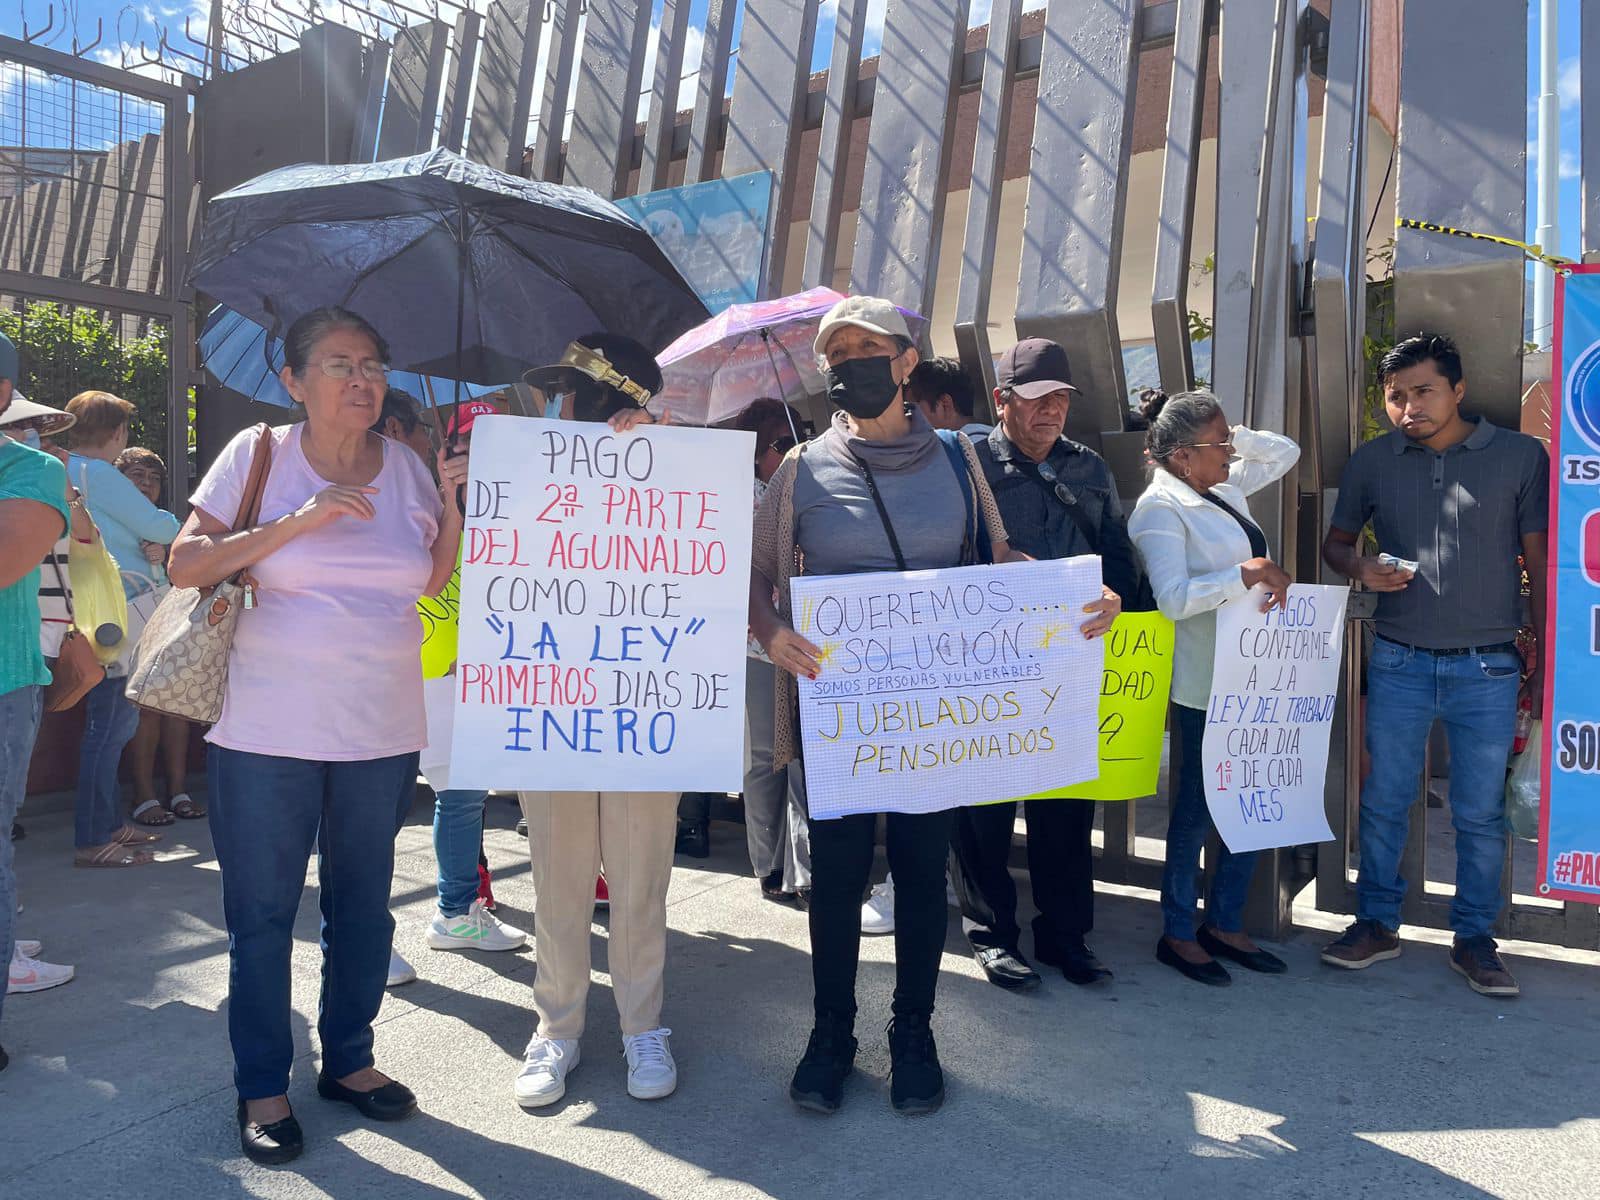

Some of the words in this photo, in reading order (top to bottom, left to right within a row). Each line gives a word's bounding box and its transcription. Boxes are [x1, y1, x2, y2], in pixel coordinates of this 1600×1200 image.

[541, 430, 653, 481] PAGO
[467, 480, 511, 520] DE
[601, 483, 720, 531] PARTE
[464, 527, 530, 566] DEL
[547, 529, 726, 575] AGUINALDO
[486, 575, 586, 615] COMO
[598, 580, 681, 618] DICE
[1109, 629, 1163, 657] UAL
[1239, 627, 1331, 660] CONFORME
[461, 664, 598, 706] PRIMEROS
[608, 670, 682, 709] DIAS
[691, 673, 729, 710] DE
[814, 679, 861, 695] SOMOS
[867, 673, 937, 691] PERSONAS
[944, 663, 1042, 683] VULNERABLES
[1245, 664, 1257, 691] A
[1269, 665, 1297, 692] LA
[817, 691, 1022, 742] JUBILADOS
[1040, 684, 1062, 714] Y
[1208, 695, 1250, 724] LEY
[1250, 696, 1280, 724] DEL
[1286, 694, 1335, 723] TRABAJO
[852, 726, 1055, 776] PENSIONADOS
[1227, 728, 1269, 757] CADA
[1271, 727, 1300, 755] DIA
[1560, 723, 1600, 770] SO
[1240, 760, 1261, 789] DE
[1267, 758, 1303, 788] CADA
[1239, 788, 1283, 824] MES
